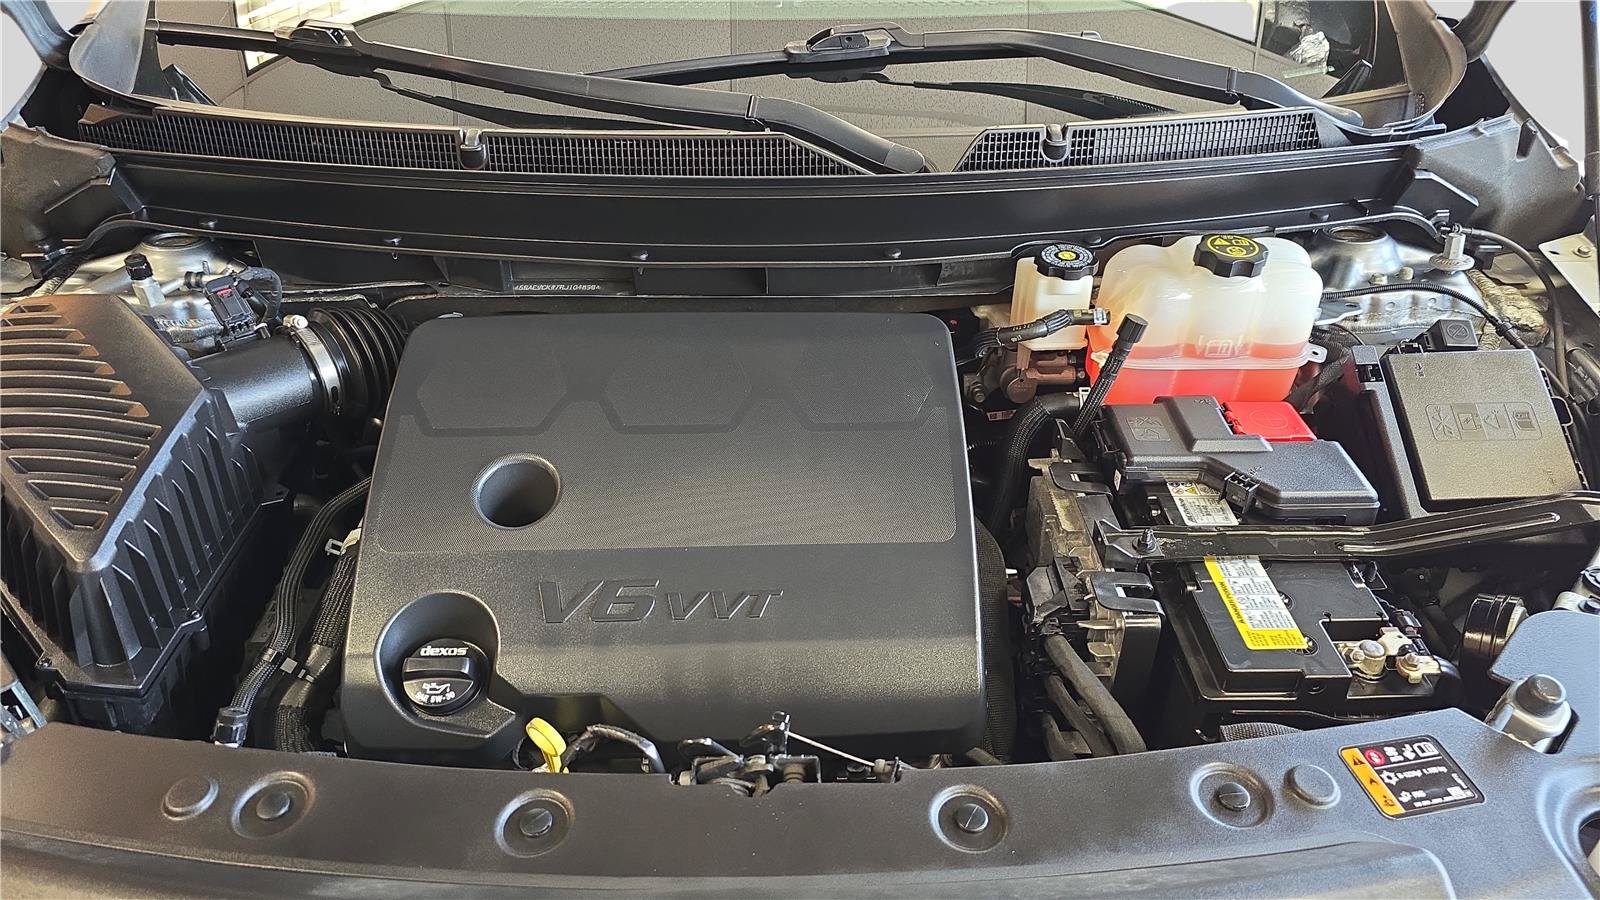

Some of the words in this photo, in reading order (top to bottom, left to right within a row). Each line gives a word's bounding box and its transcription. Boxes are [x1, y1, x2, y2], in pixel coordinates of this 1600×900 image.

[538, 579, 660, 624] V6
[666, 590, 784, 621] VVT
[420, 645, 469, 656] dexos
